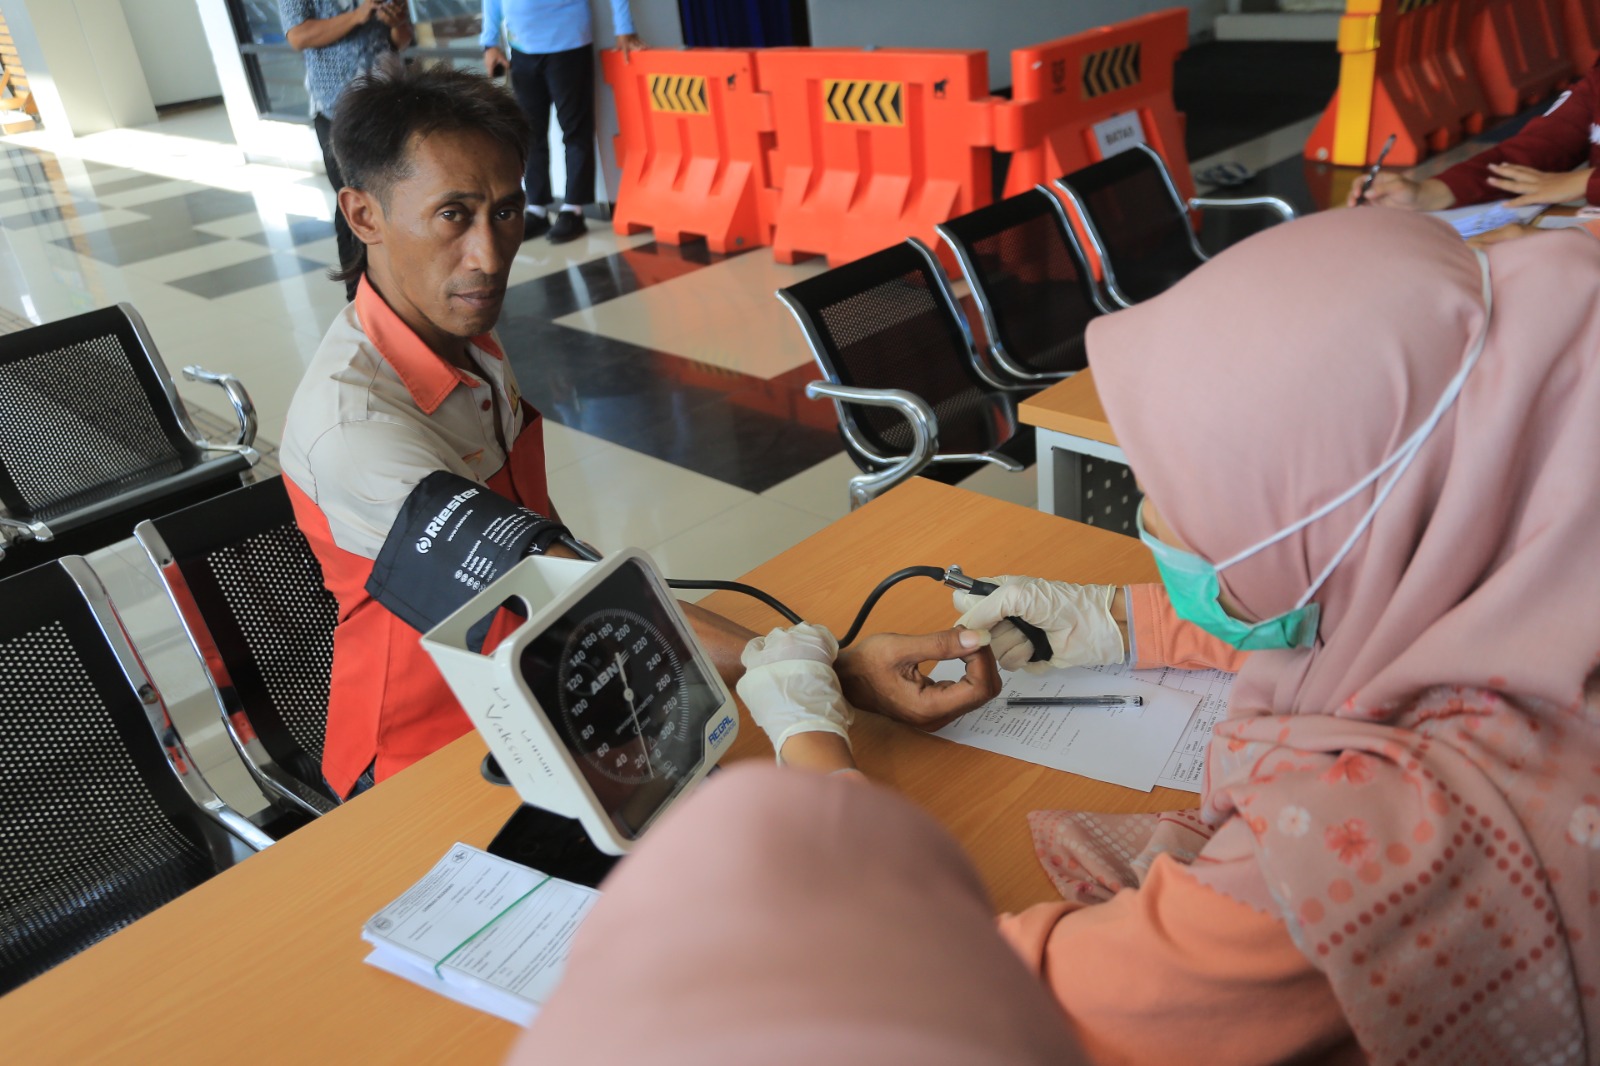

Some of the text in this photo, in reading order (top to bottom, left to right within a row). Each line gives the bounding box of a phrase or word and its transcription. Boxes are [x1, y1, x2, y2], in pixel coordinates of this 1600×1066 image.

[424, 487, 480, 539] Riester
[581, 632, 598, 649] 160
[598, 623, 614, 640] 180
[614, 624, 631, 642] 200
[632, 636, 648, 654] 220
[569, 650, 586, 668] 140
[646, 653, 662, 671] 240
[566, 673, 584, 692] 120
[655, 674, 671, 692] 260
[571, 699, 589, 717] 100
[662, 696, 678, 714] 280
[581, 724, 595, 740] 80
[660, 722, 676, 740] 300
[708, 716, 733, 744] REGAL
[596, 742, 610, 757] 60
[654, 749, 662, 759] 0
[616, 753, 628, 768] 40
[634, 753, 647, 768] 20
